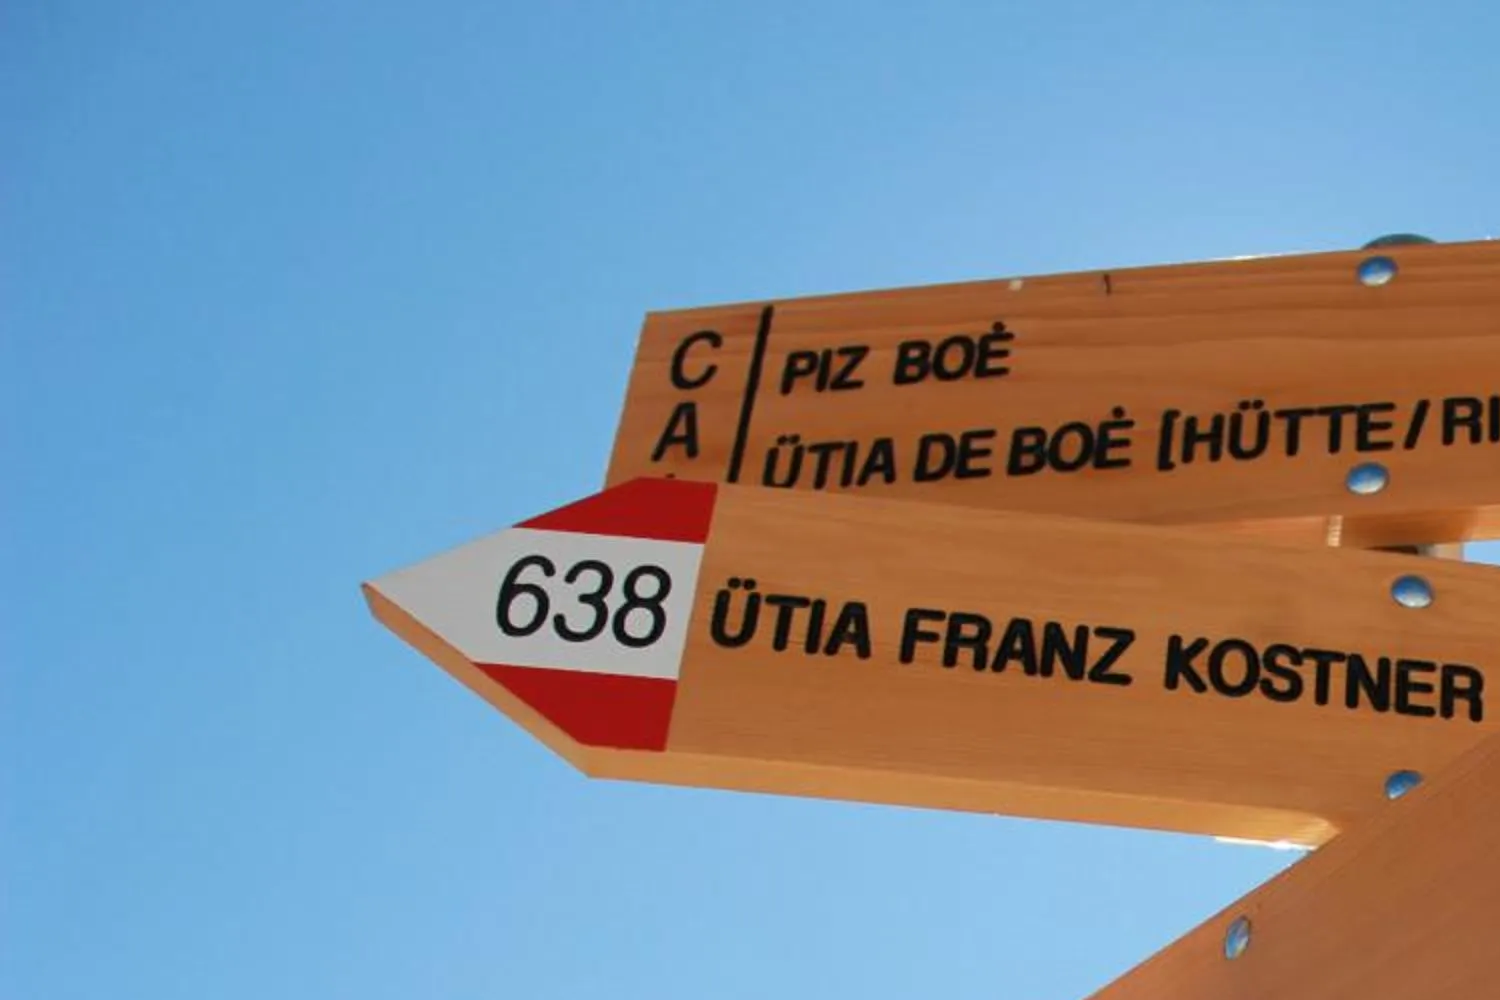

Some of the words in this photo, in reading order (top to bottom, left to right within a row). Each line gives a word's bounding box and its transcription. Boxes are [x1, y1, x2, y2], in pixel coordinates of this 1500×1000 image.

[651, 329, 723, 478] CA
[780, 345, 870, 396] PIZ
[762, 434, 897, 490] ÜTIA
[912, 429, 996, 483] DE
[495, 554, 672, 649] 638
[710, 576, 872, 660] ÜTIA
[898, 607, 1136, 687] FRANZ
[1163, 634, 1484, 723] KOSTNER
